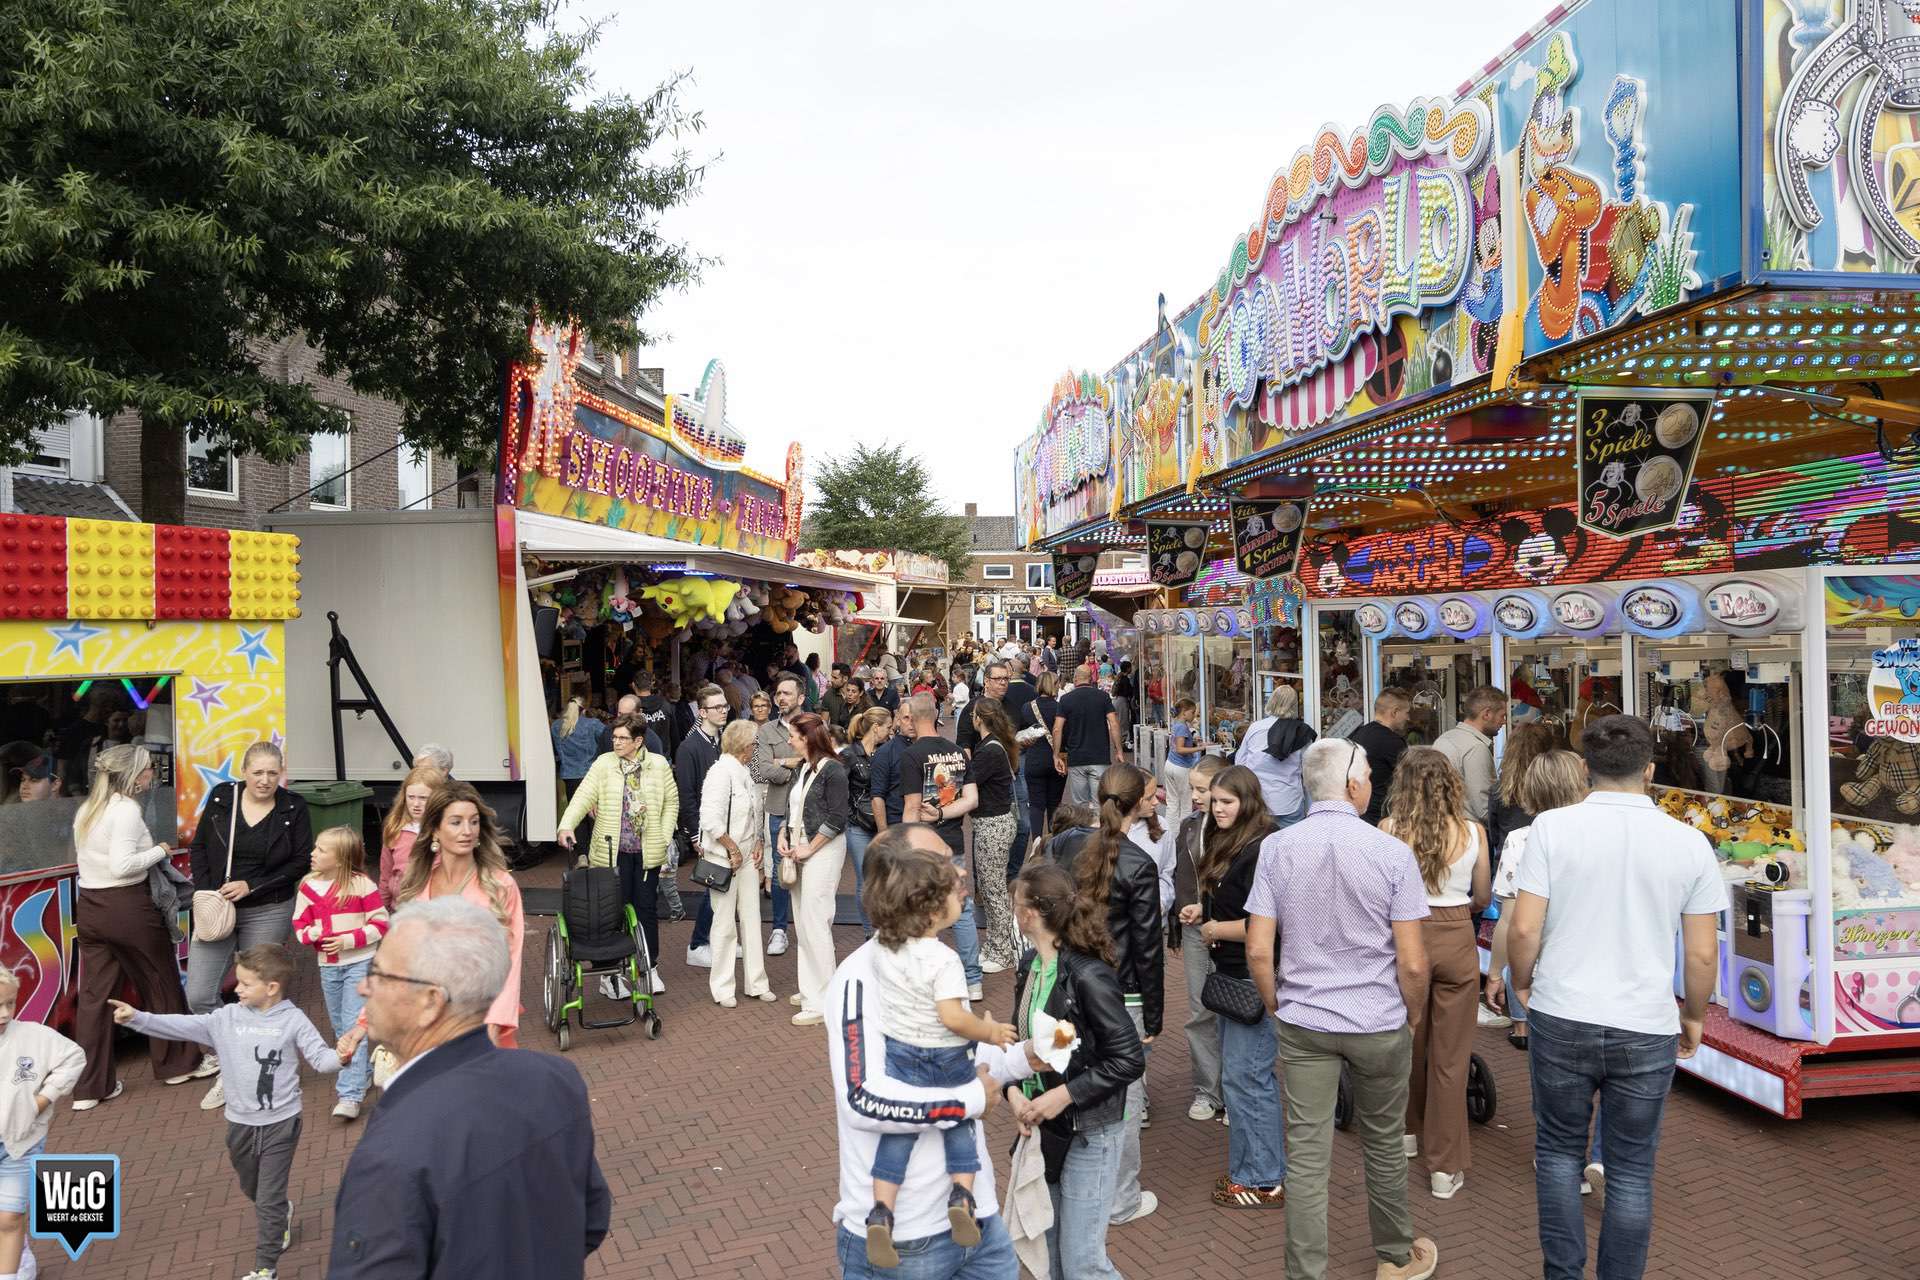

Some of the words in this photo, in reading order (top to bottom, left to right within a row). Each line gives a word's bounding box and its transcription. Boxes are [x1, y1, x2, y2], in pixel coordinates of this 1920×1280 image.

[1586, 408, 1608, 437] 3
[1585, 428, 1652, 464] Spiele
[566, 430, 713, 521] SHOOTING
[1585, 489, 1609, 523] 5
[1602, 492, 1666, 529] Spiele
[1151, 528, 1161, 542] 3
[1152, 539, 1183, 554] Spiele
[1243, 552, 1252, 569] 1
[1253, 534, 1289, 564] Spiel
[1153, 566, 1165, 581] 5
[1884, 703, 1909, 715] HIER
[854, 1094, 925, 1120] TOMMY
